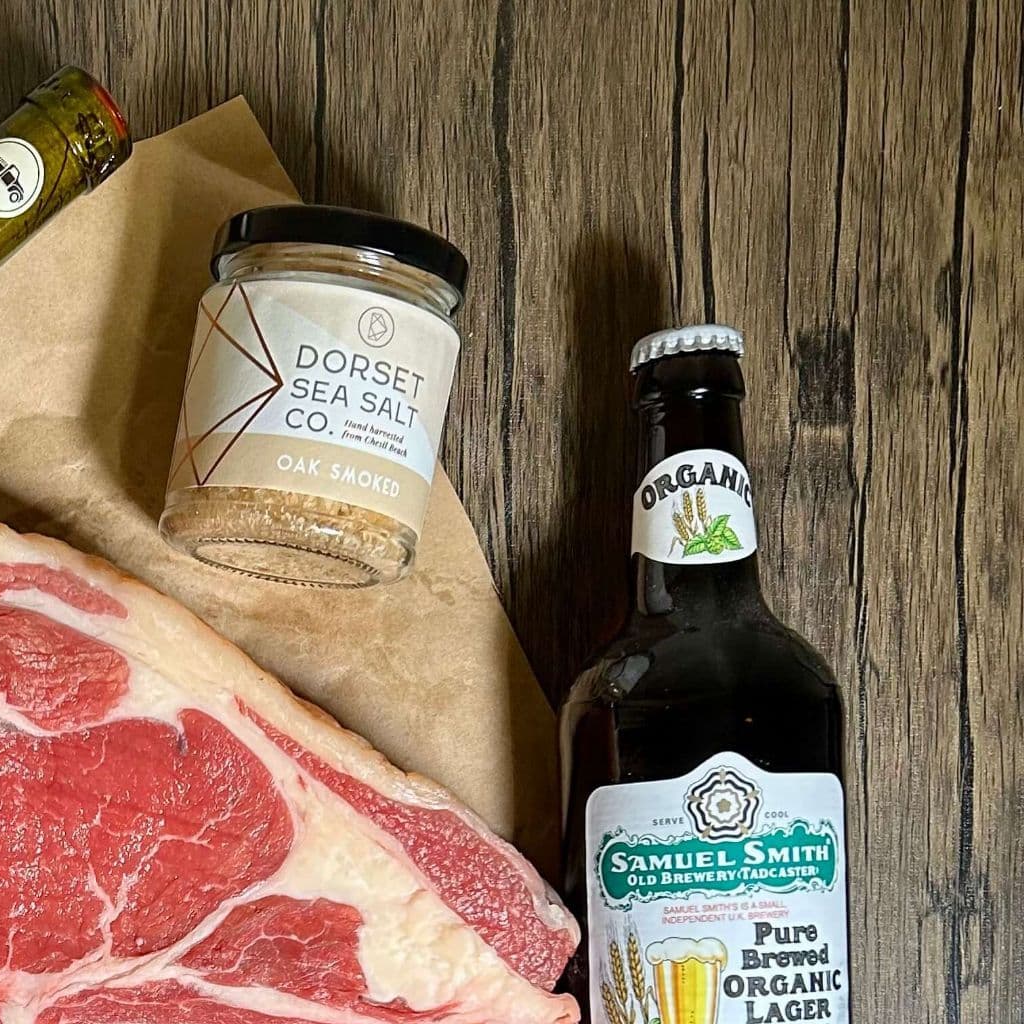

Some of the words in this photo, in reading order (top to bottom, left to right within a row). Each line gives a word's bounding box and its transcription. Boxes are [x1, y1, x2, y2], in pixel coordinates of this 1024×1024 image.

[295, 344, 425, 399] DORSET
[290, 378, 348, 408] SEA
[360, 391, 418, 429] SALT
[285, 408, 334, 435] CO.
[344, 419, 368, 432] Hand
[369, 424, 404, 444] harvested
[341, 430, 362, 441] from
[364, 436, 388, 449] Chesil
[276, 454, 321, 476] OAK
[330, 463, 400, 497] SMOKED
[641, 461, 752, 511] ORGANIC
[652, 817, 685, 826] SERVE
[764, 811, 790, 819] COOL
[610, 851, 736, 873] SAMUEL
[627, 875, 657, 886] OLD
[661, 869, 738, 885] BREWERY
[662, 914, 726, 924] INDEPENDENT
[747, 910, 789, 920] BREWERY
[663, 905, 699, 914] SAMUEL
[702, 903, 737, 912] SMITH'S
[753, 922, 817, 945] Pure
[741, 943, 829, 970] Brewed
[723, 969, 841, 998] ORGANIC
[744, 998, 831, 1024] LAGER
